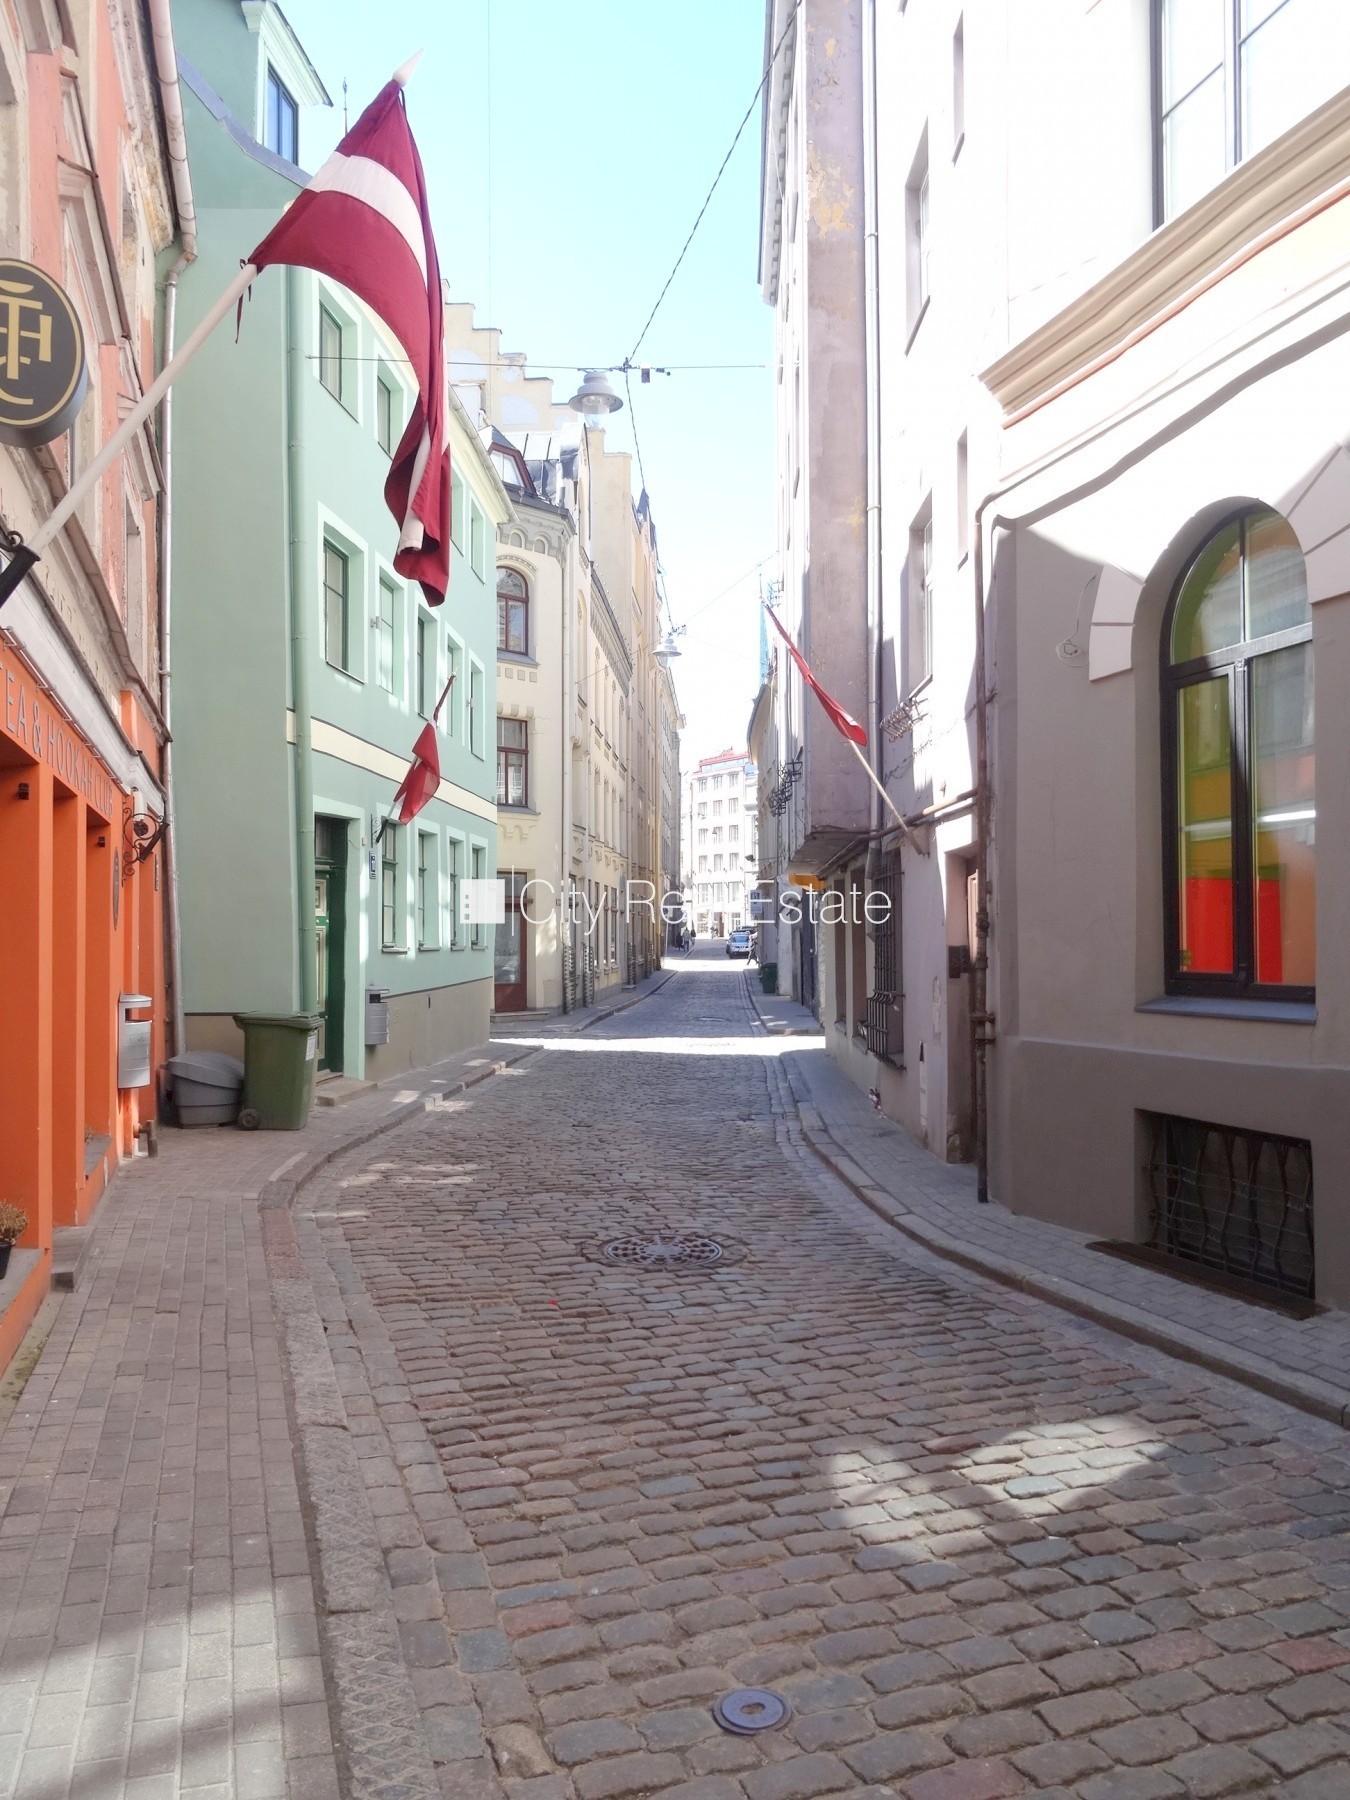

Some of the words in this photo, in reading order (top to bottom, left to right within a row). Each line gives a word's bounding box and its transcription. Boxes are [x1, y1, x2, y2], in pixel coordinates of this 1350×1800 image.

[32, 699, 43, 757] &
[47, 714, 93, 798] HOOKAH
[95, 772, 114, 819] CLUB
